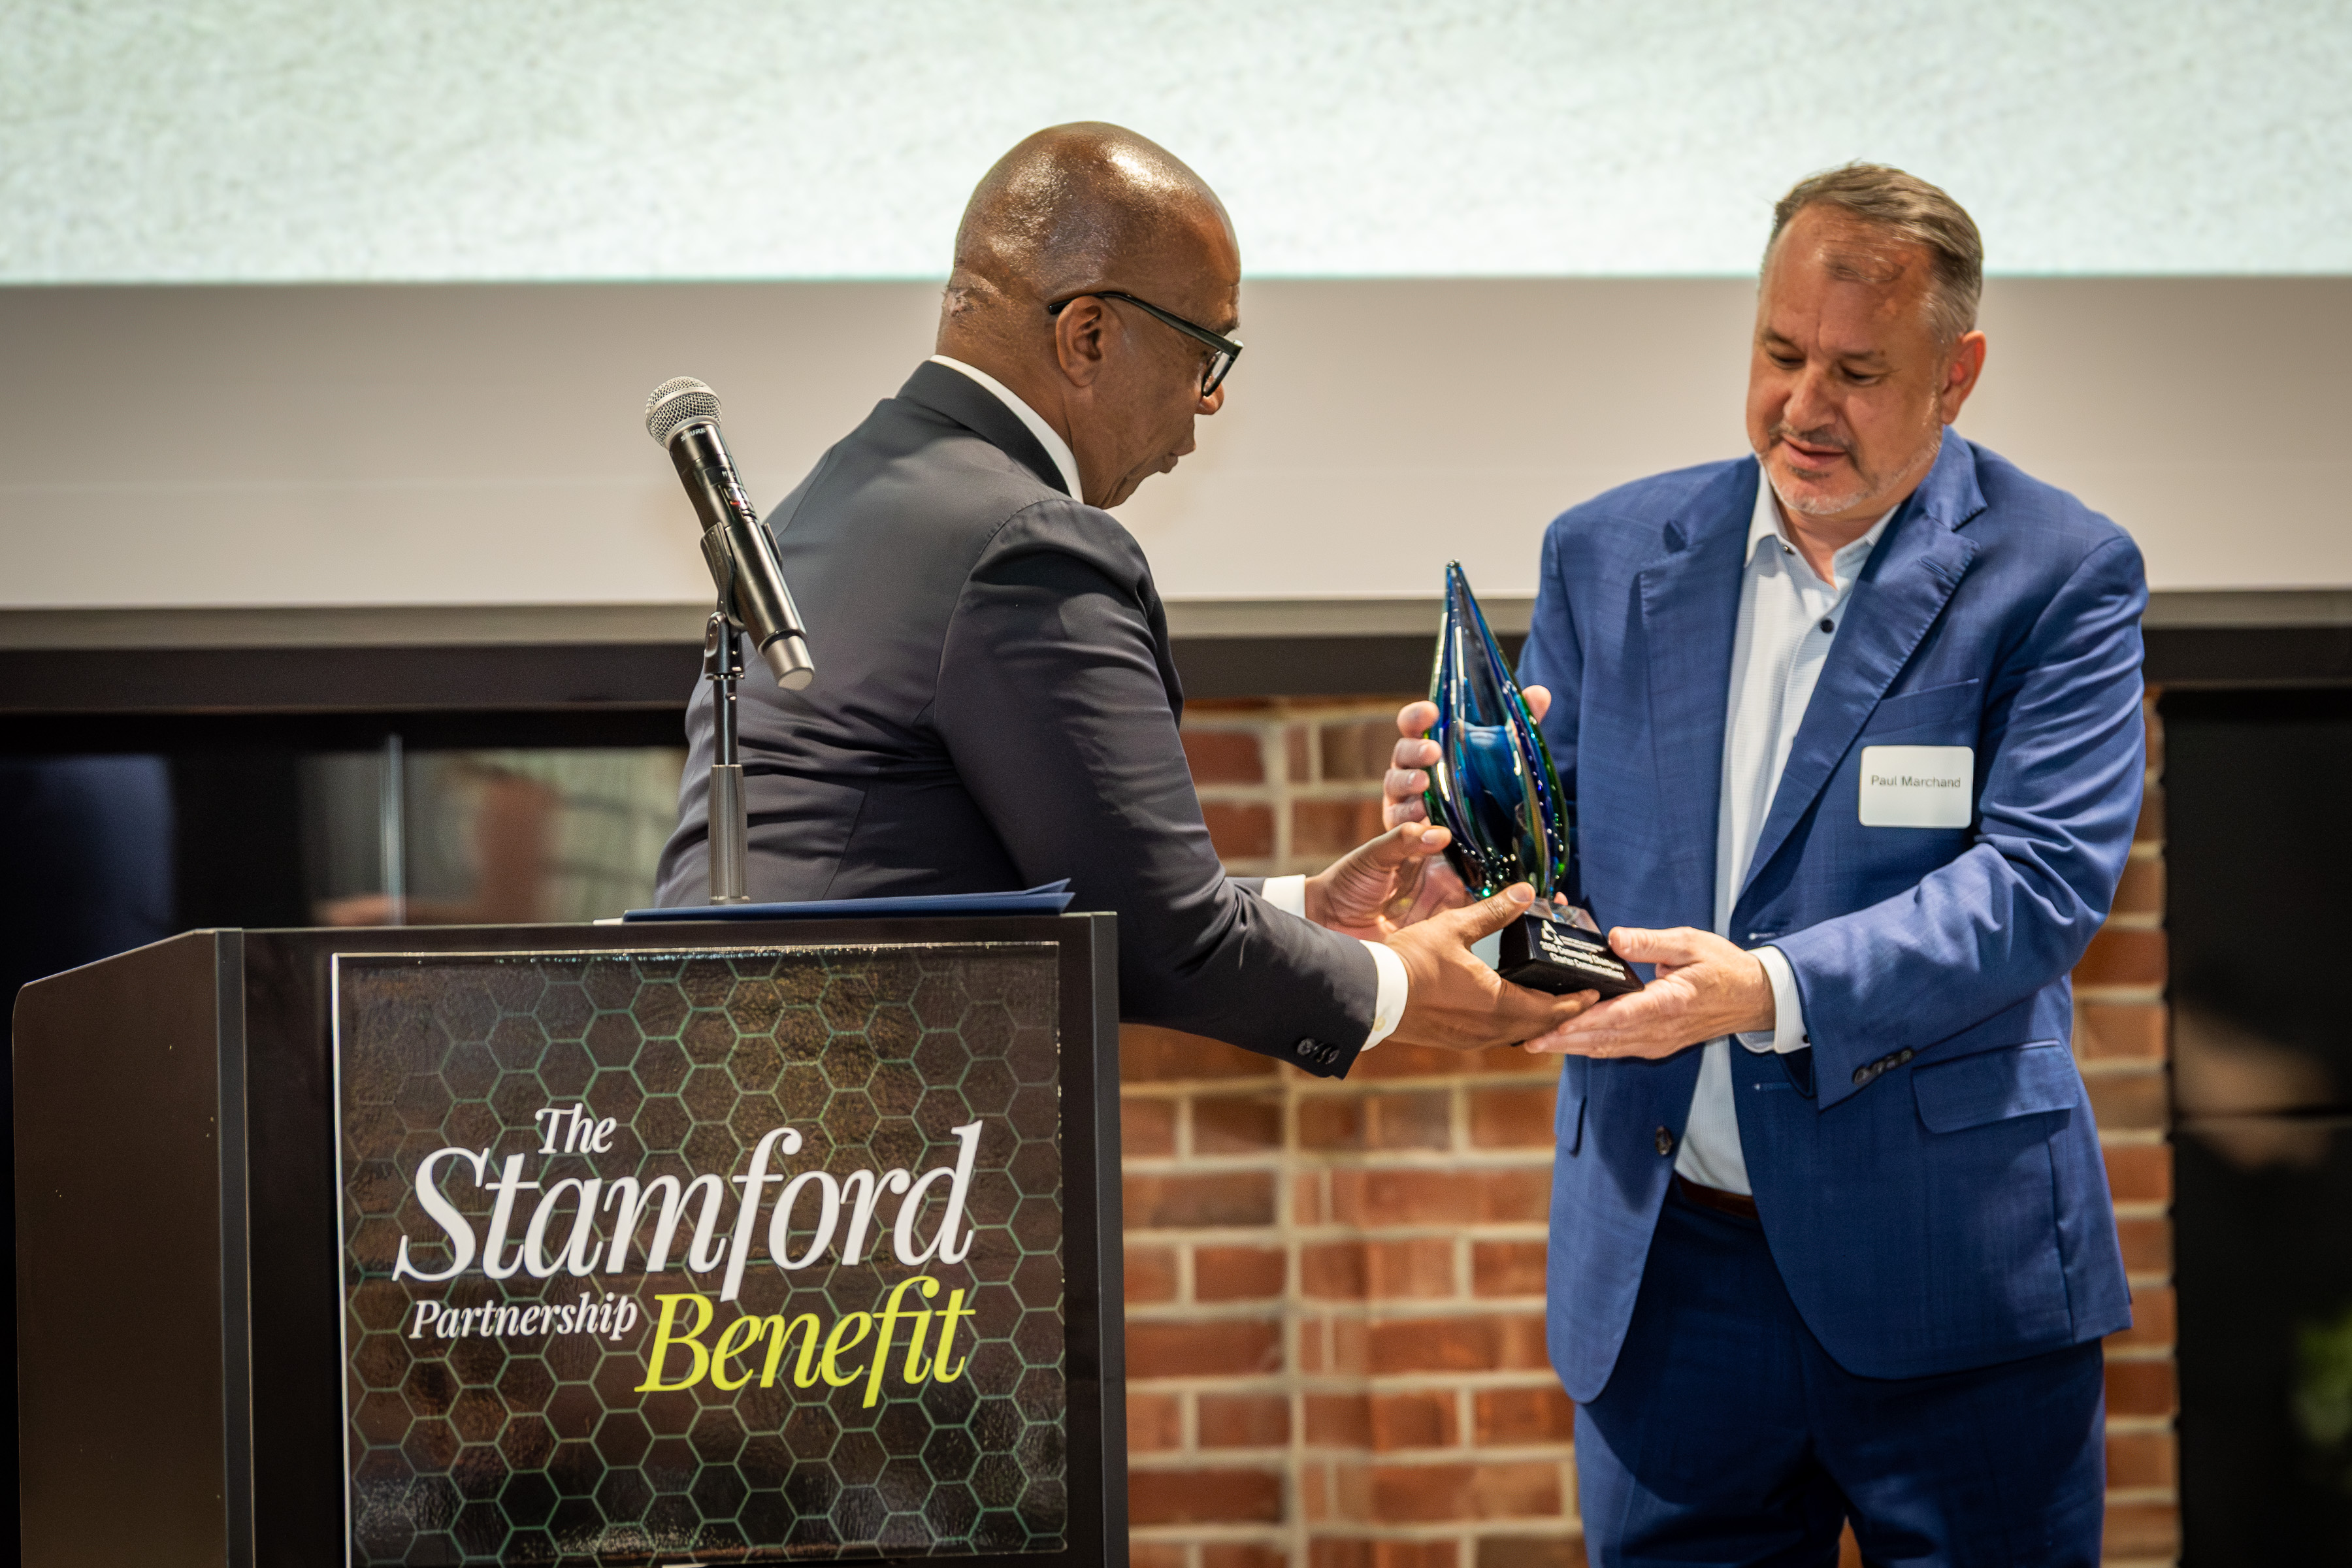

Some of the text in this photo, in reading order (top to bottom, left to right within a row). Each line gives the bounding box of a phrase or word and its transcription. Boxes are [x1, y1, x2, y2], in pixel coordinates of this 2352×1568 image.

[1871, 775, 1961, 788] Paul Marchand
[534, 1102, 617, 1154] The
[391, 1120, 983, 1303] Stamford
[408, 1275, 977, 1409] Partnership Benefit
